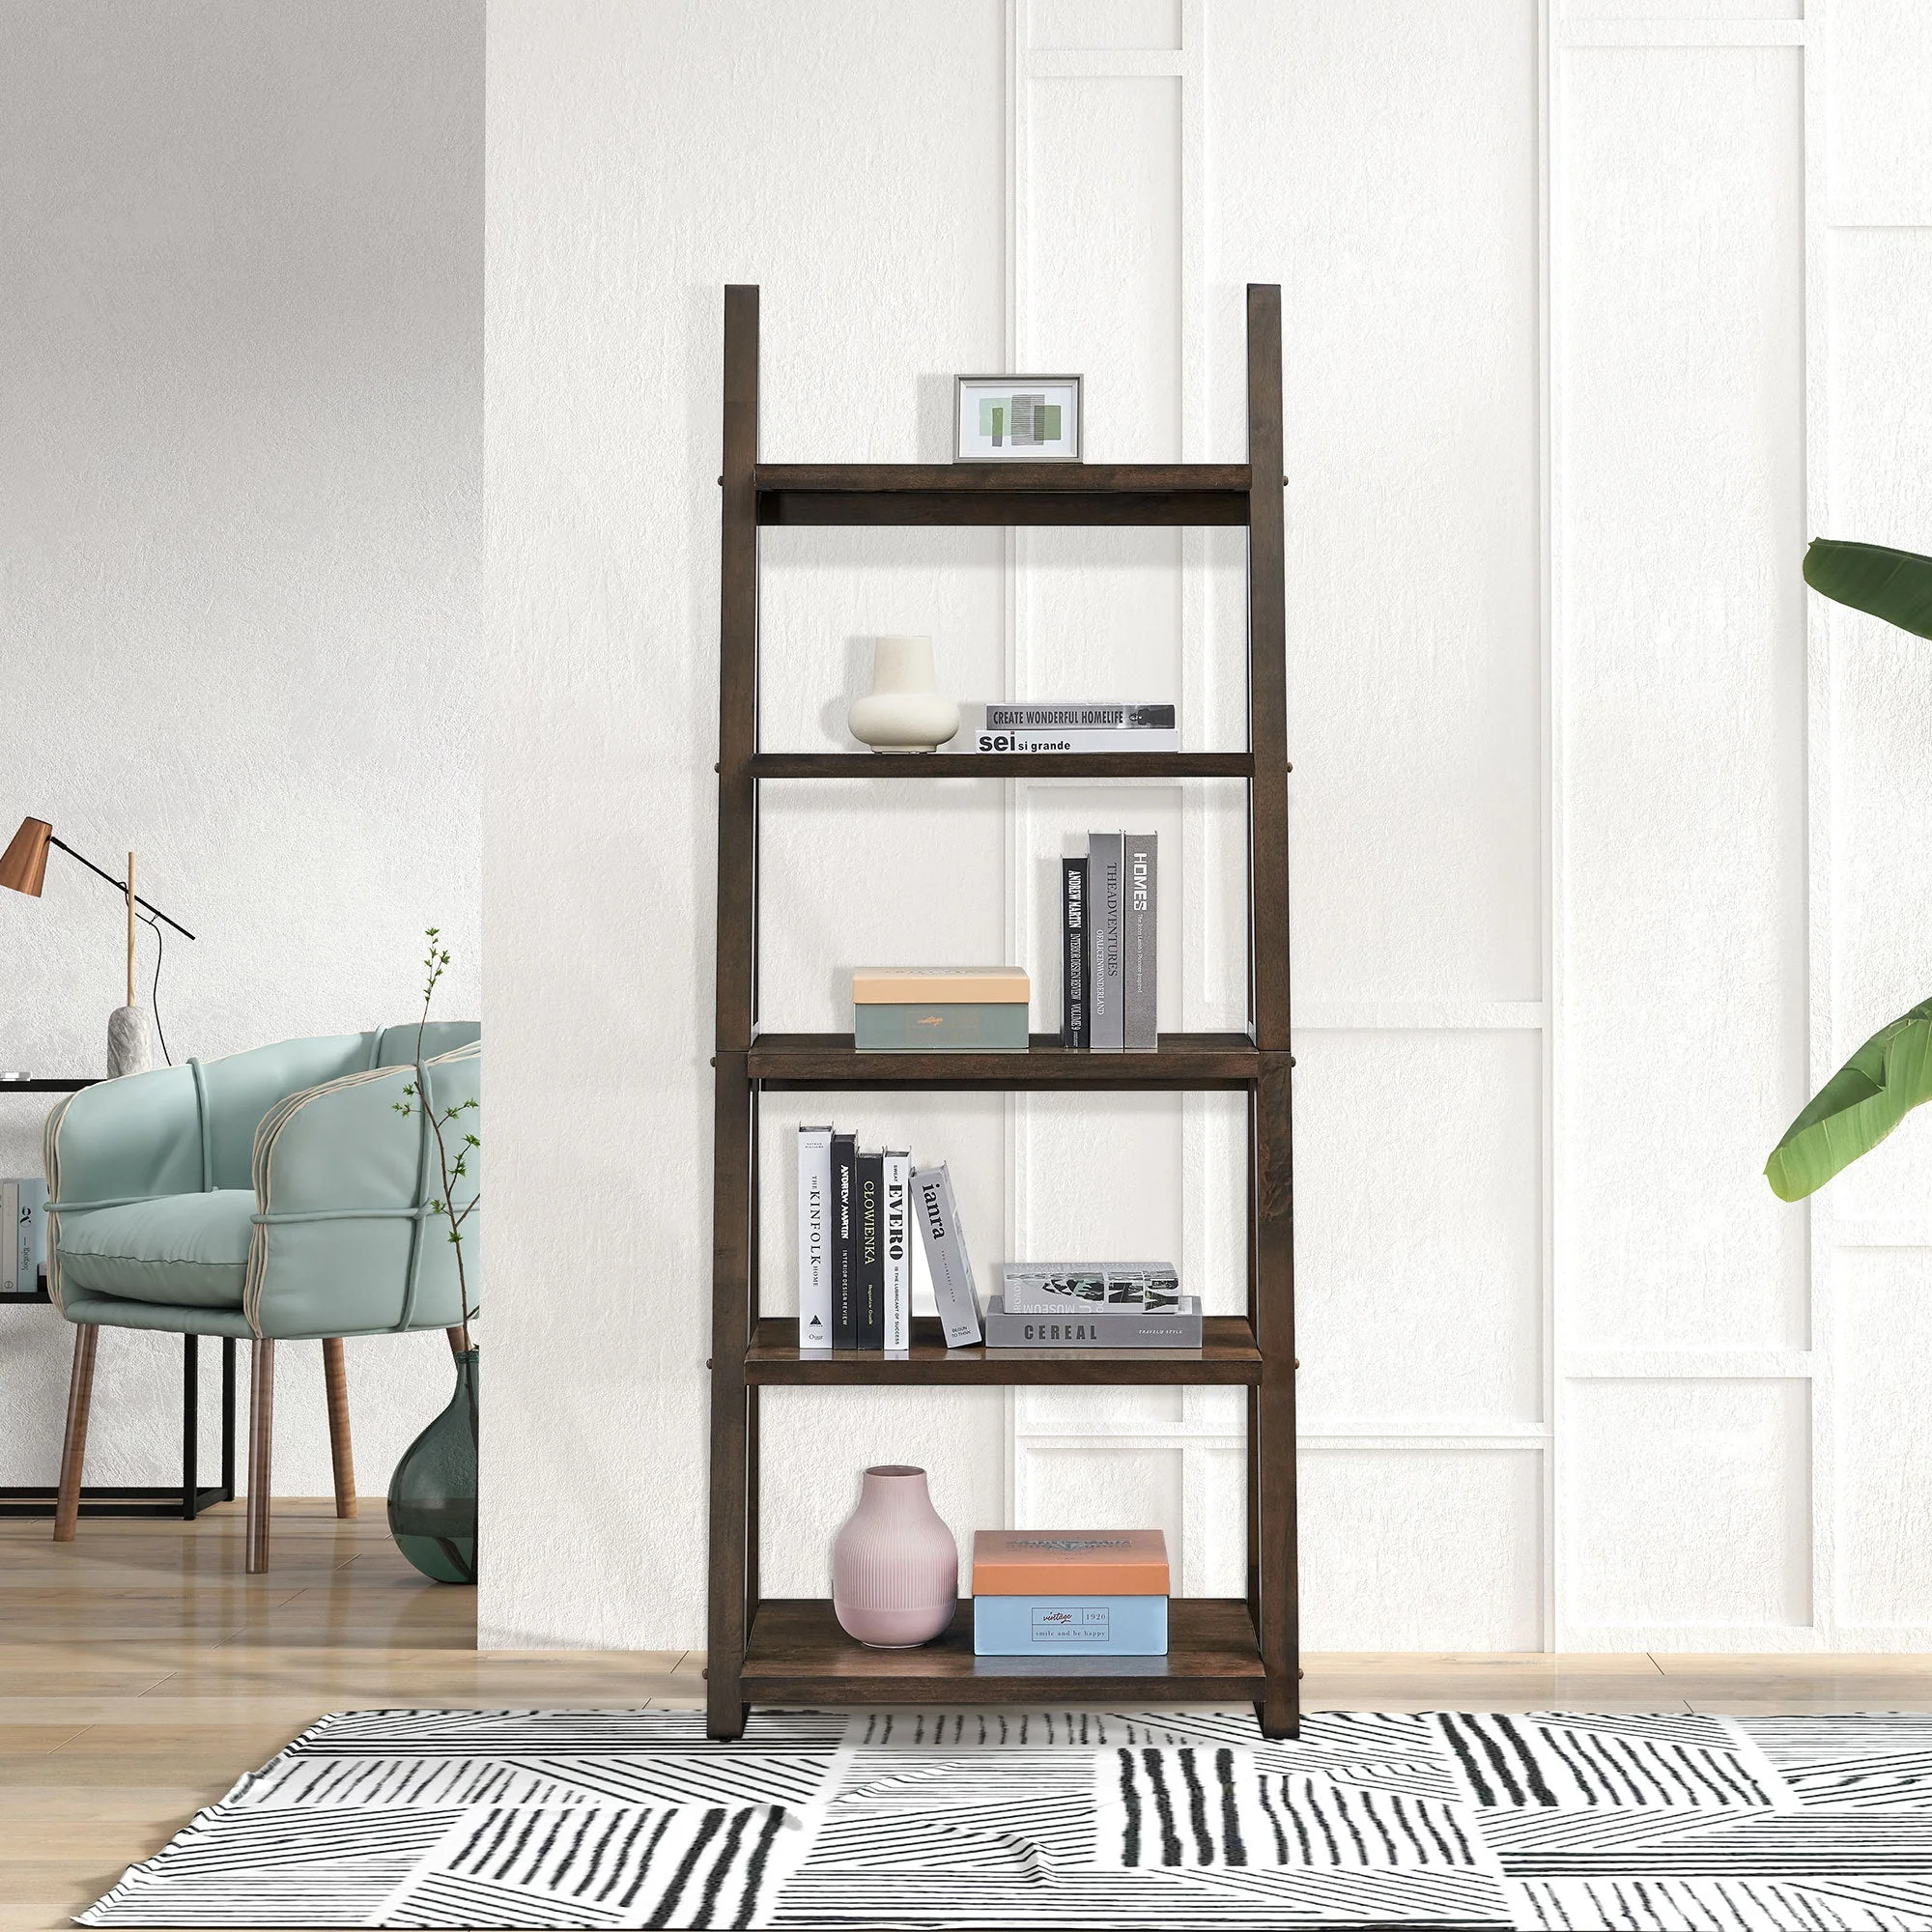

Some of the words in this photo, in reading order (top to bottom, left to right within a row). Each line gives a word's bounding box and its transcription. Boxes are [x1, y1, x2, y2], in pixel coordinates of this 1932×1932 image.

[993, 711, 1024, 724] CREATE
[1026, 711, 1079, 724] WONDERFUL
[1081, 710, 1123, 724] HOMELIFE
[979, 731, 1015, 752] sei
[1018, 741, 1028, 751] si
[1031, 741, 1071, 753] grande
[1068, 870, 1082, 900] ANDREW
[1133, 852, 1147, 911] HOMES
[1068, 901, 1082, 928] MARTIN
[840, 1165, 849, 1204] ANDREW
[810, 1190, 821, 1265] KINFOLK
[889, 1184, 903, 1261] EVERO
[923, 1183, 946, 1240] ianra
[1024, 1324, 1097, 1340] CEREAL
